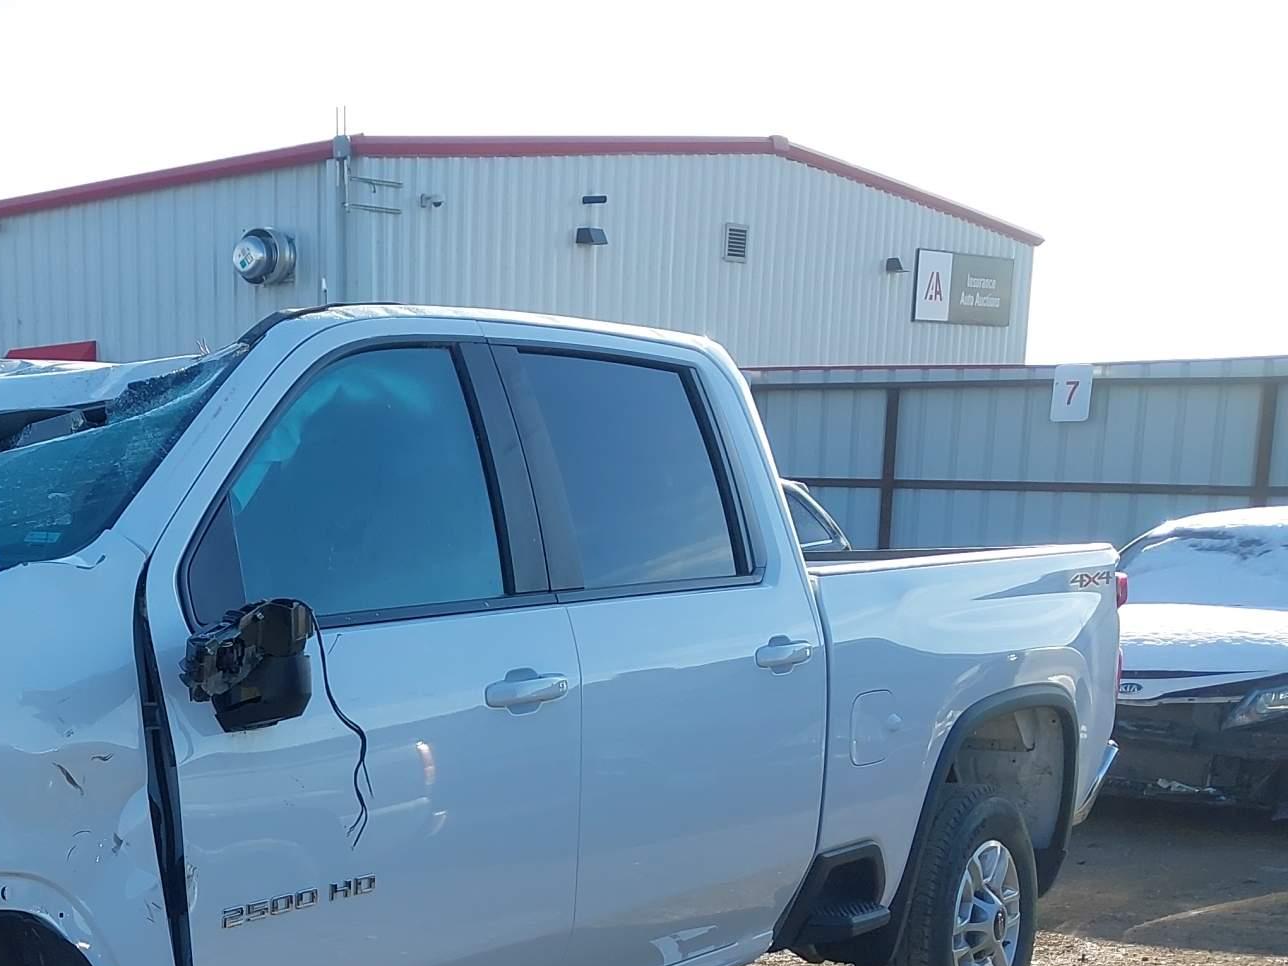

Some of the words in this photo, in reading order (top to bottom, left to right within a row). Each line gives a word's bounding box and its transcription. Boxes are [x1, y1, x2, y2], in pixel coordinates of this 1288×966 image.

[967, 274, 996, 289] Insurance
[960, 292, 974, 306] Auto
[975, 292, 1000, 308] Auctions
[1065, 380, 1080, 406] 7
[222, 887, 319, 929] 2500
[329, 872, 376, 901] HD
